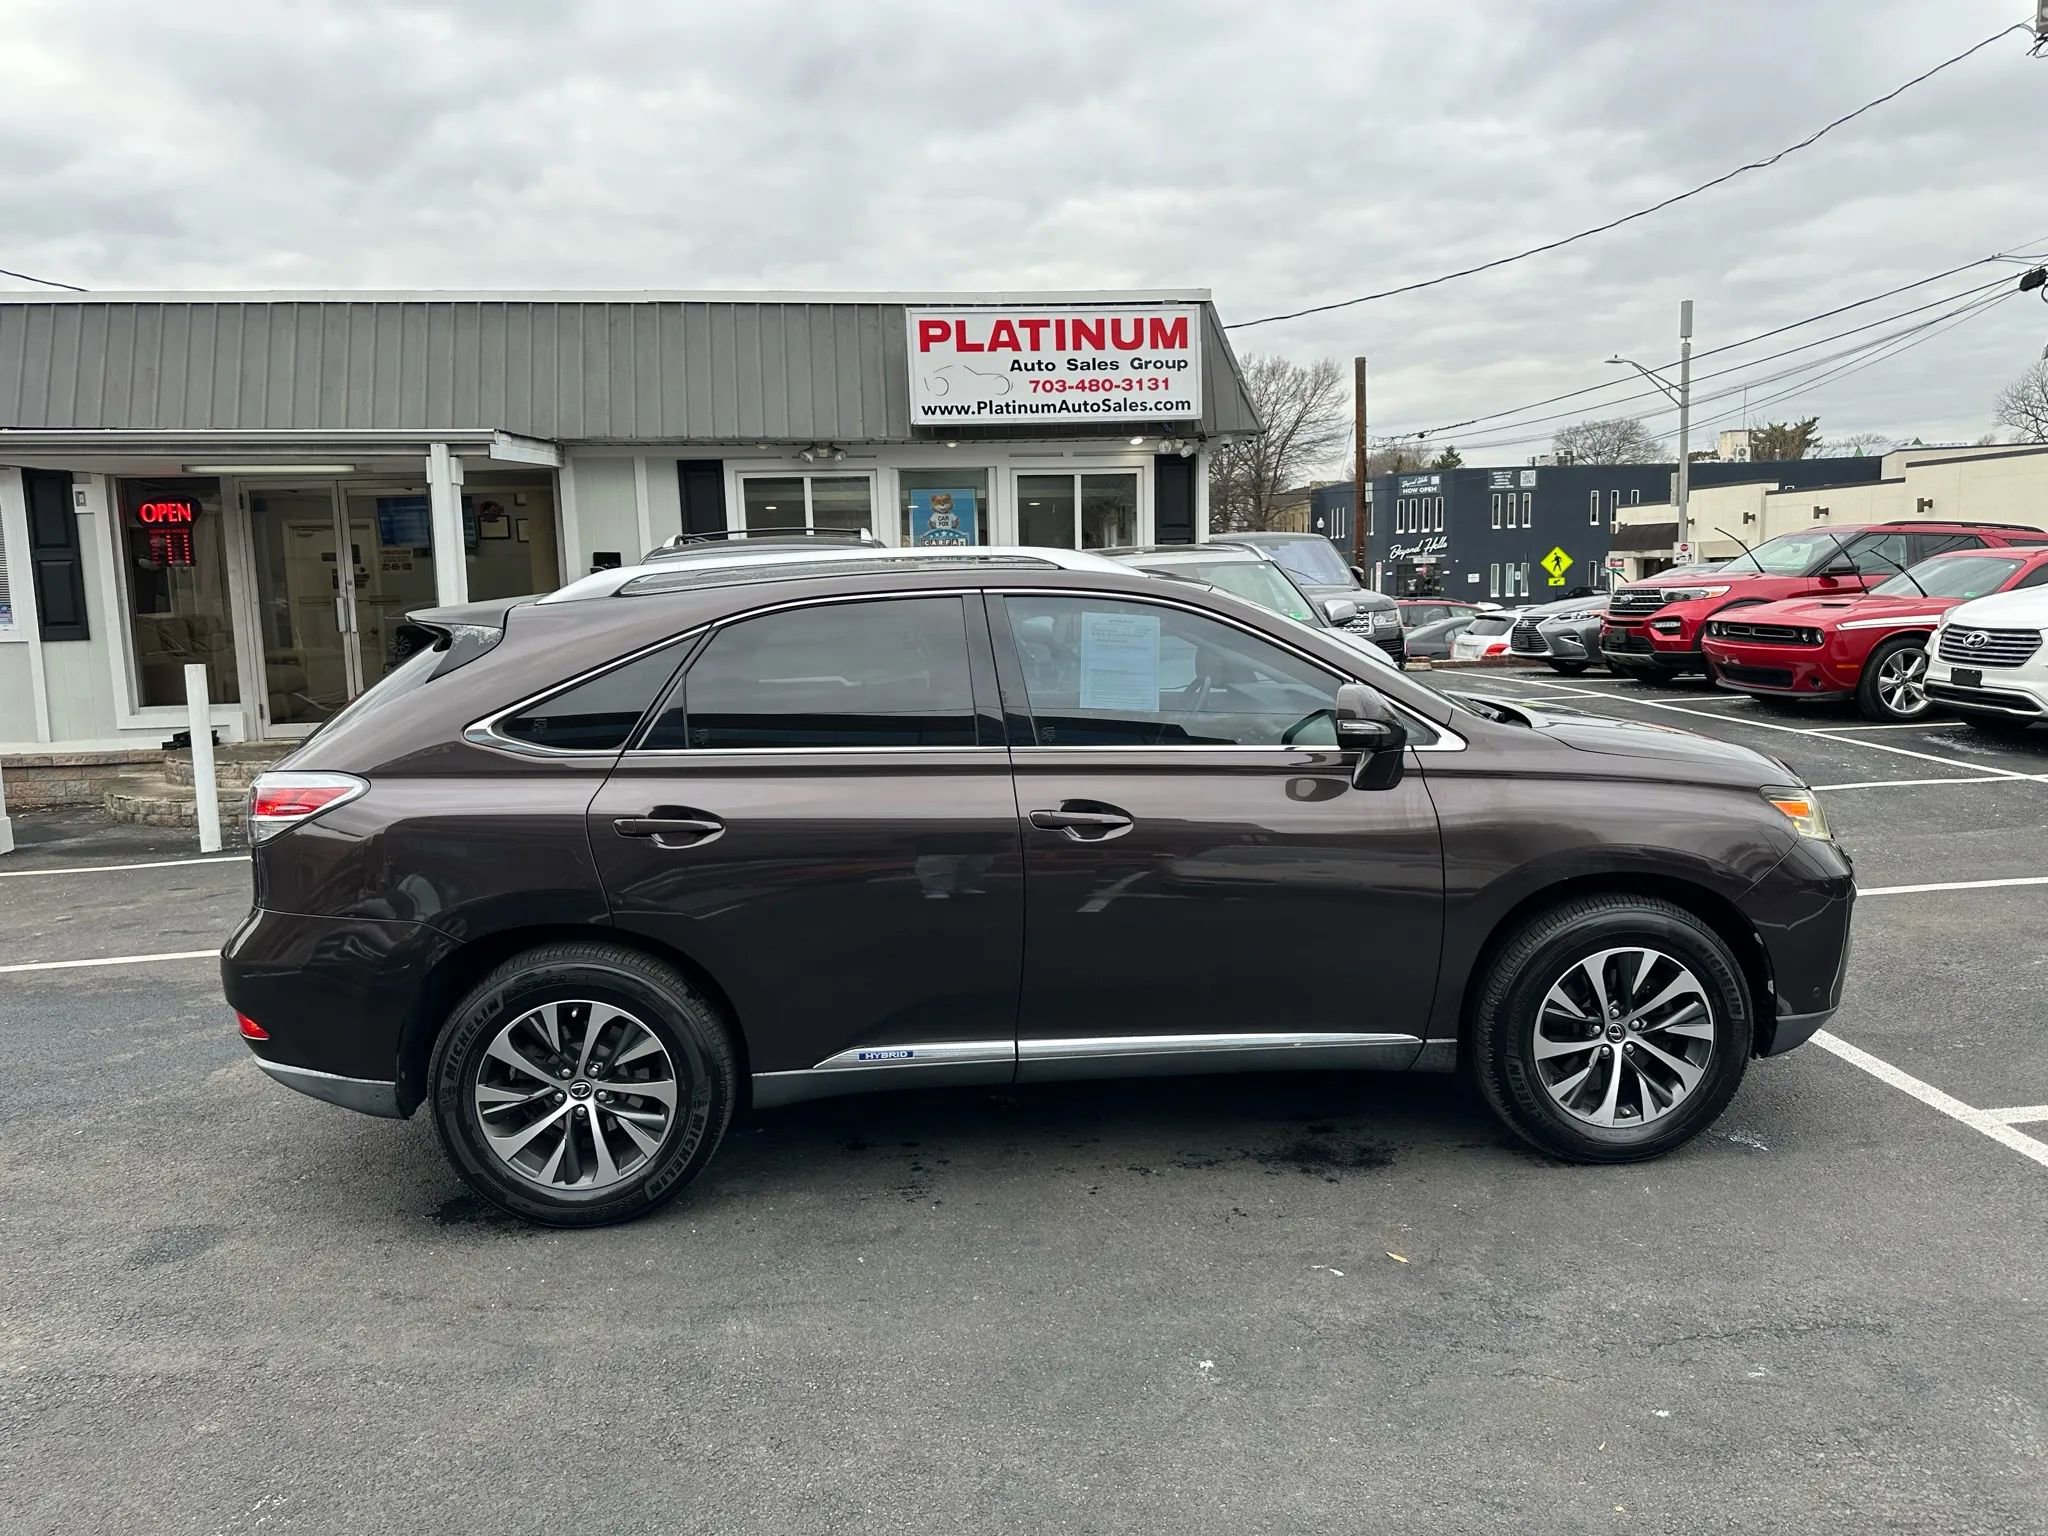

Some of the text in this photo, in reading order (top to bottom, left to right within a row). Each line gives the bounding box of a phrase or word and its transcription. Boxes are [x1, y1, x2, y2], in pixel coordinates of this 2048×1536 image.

[918, 317, 1188, 353] PLATINUM
[1009, 357, 1188, 372] Auto Sales Group
[1029, 377, 1170, 394] 703-480-3131
[921, 397, 1191, 416] www.PlatinumAutoSales.com
[140, 503, 192, 523] OPEN
[923, 538, 966, 546] CARFAX
[1389, 536, 1448, 560] Beyond Hello
[445, 997, 500, 1082] MICHELIN
[865, 1051, 908, 1060] HYBRID
[648, 1113, 705, 1196] MICHELIN
